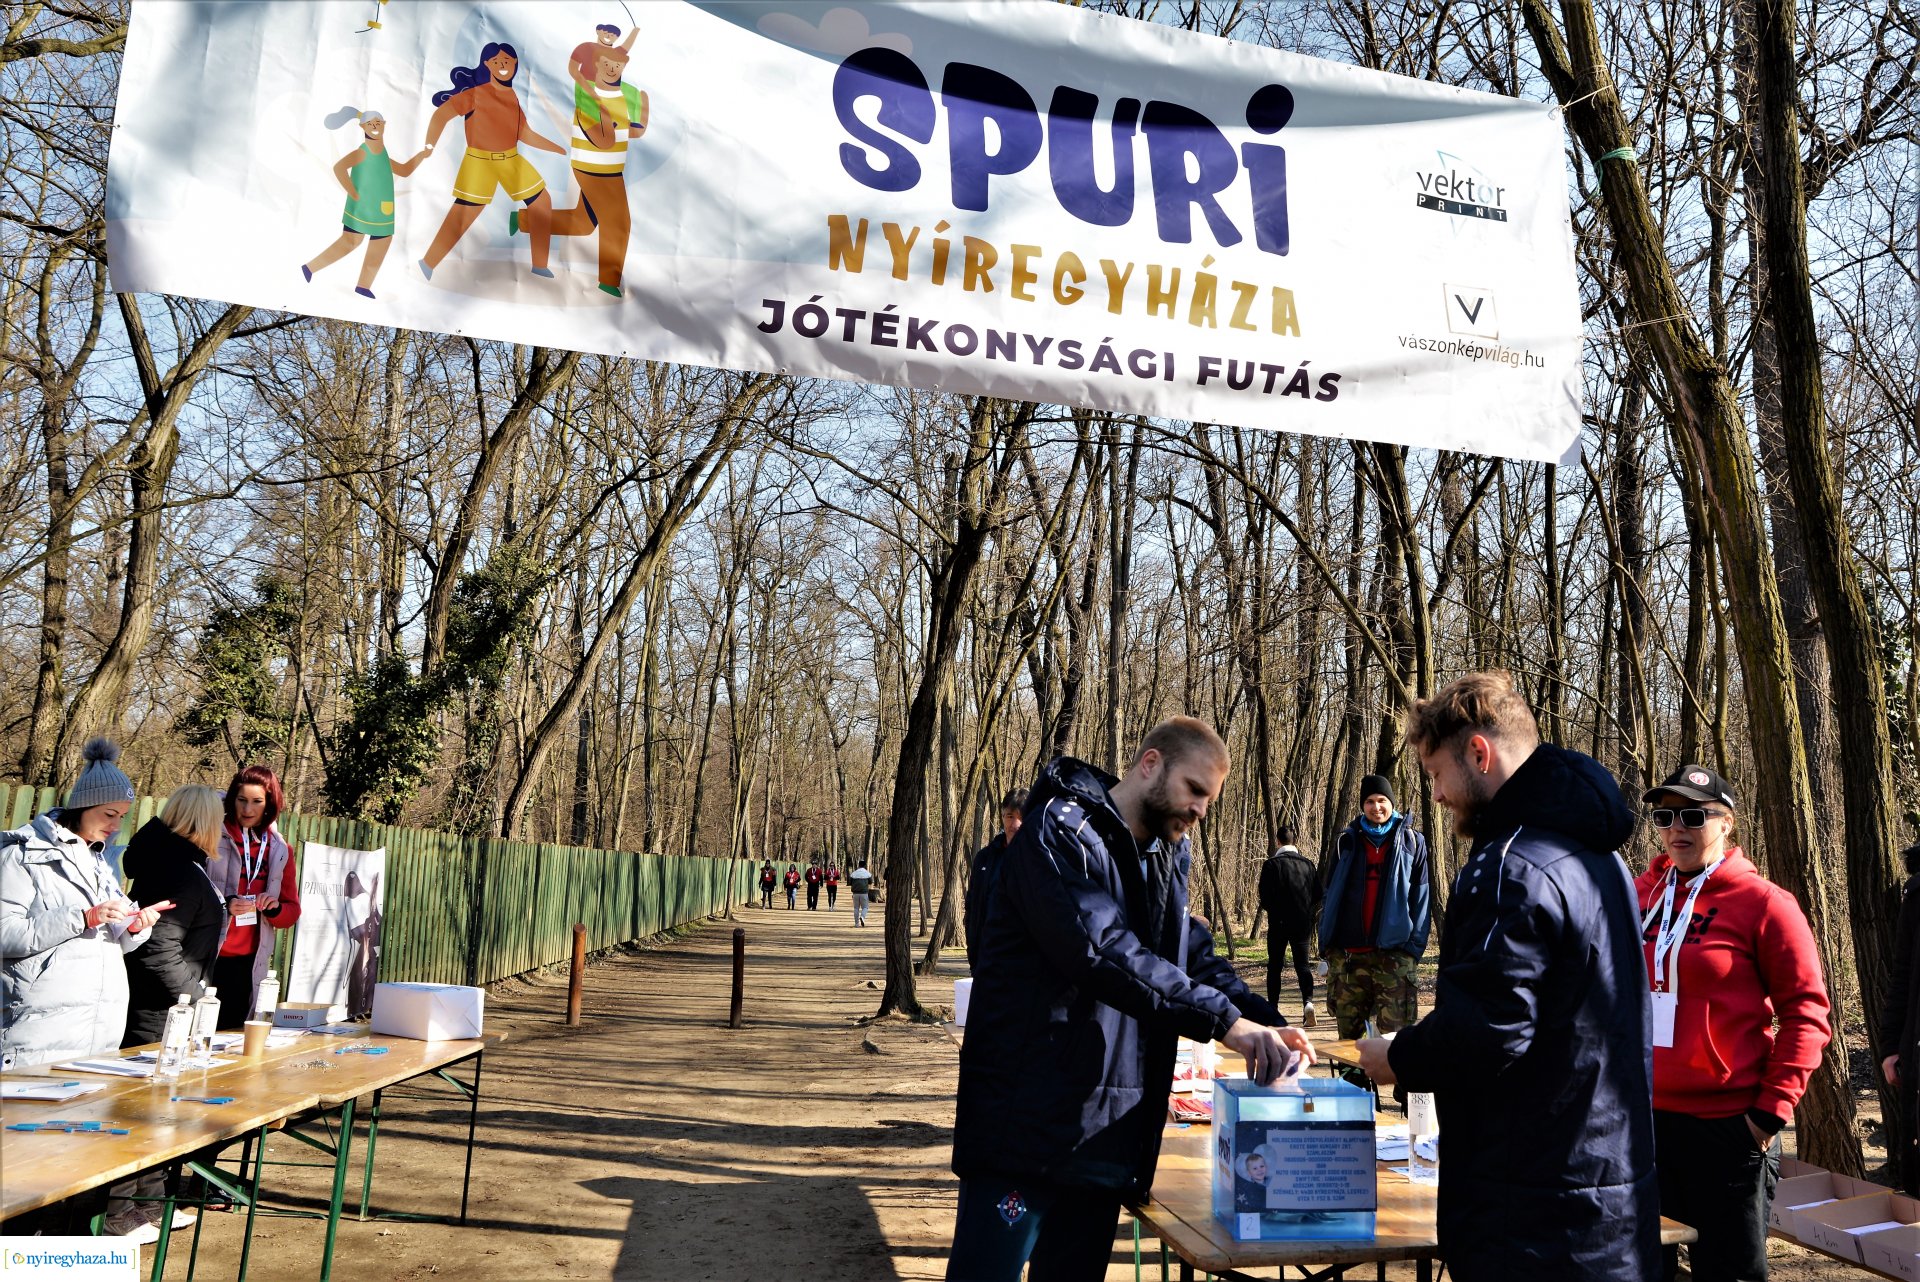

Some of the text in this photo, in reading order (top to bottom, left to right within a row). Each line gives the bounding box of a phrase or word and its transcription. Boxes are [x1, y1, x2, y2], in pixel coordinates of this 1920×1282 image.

[1416, 169, 1506, 207] vektor
[1418, 195, 1505, 220] PRINT
[827, 214, 1302, 338] NYÍREGYHÁZA
[756, 294, 1343, 403] JÓTÉKONYSÁGI FUTÁS
[1398, 334, 1545, 369] vászonképvilág.hu
